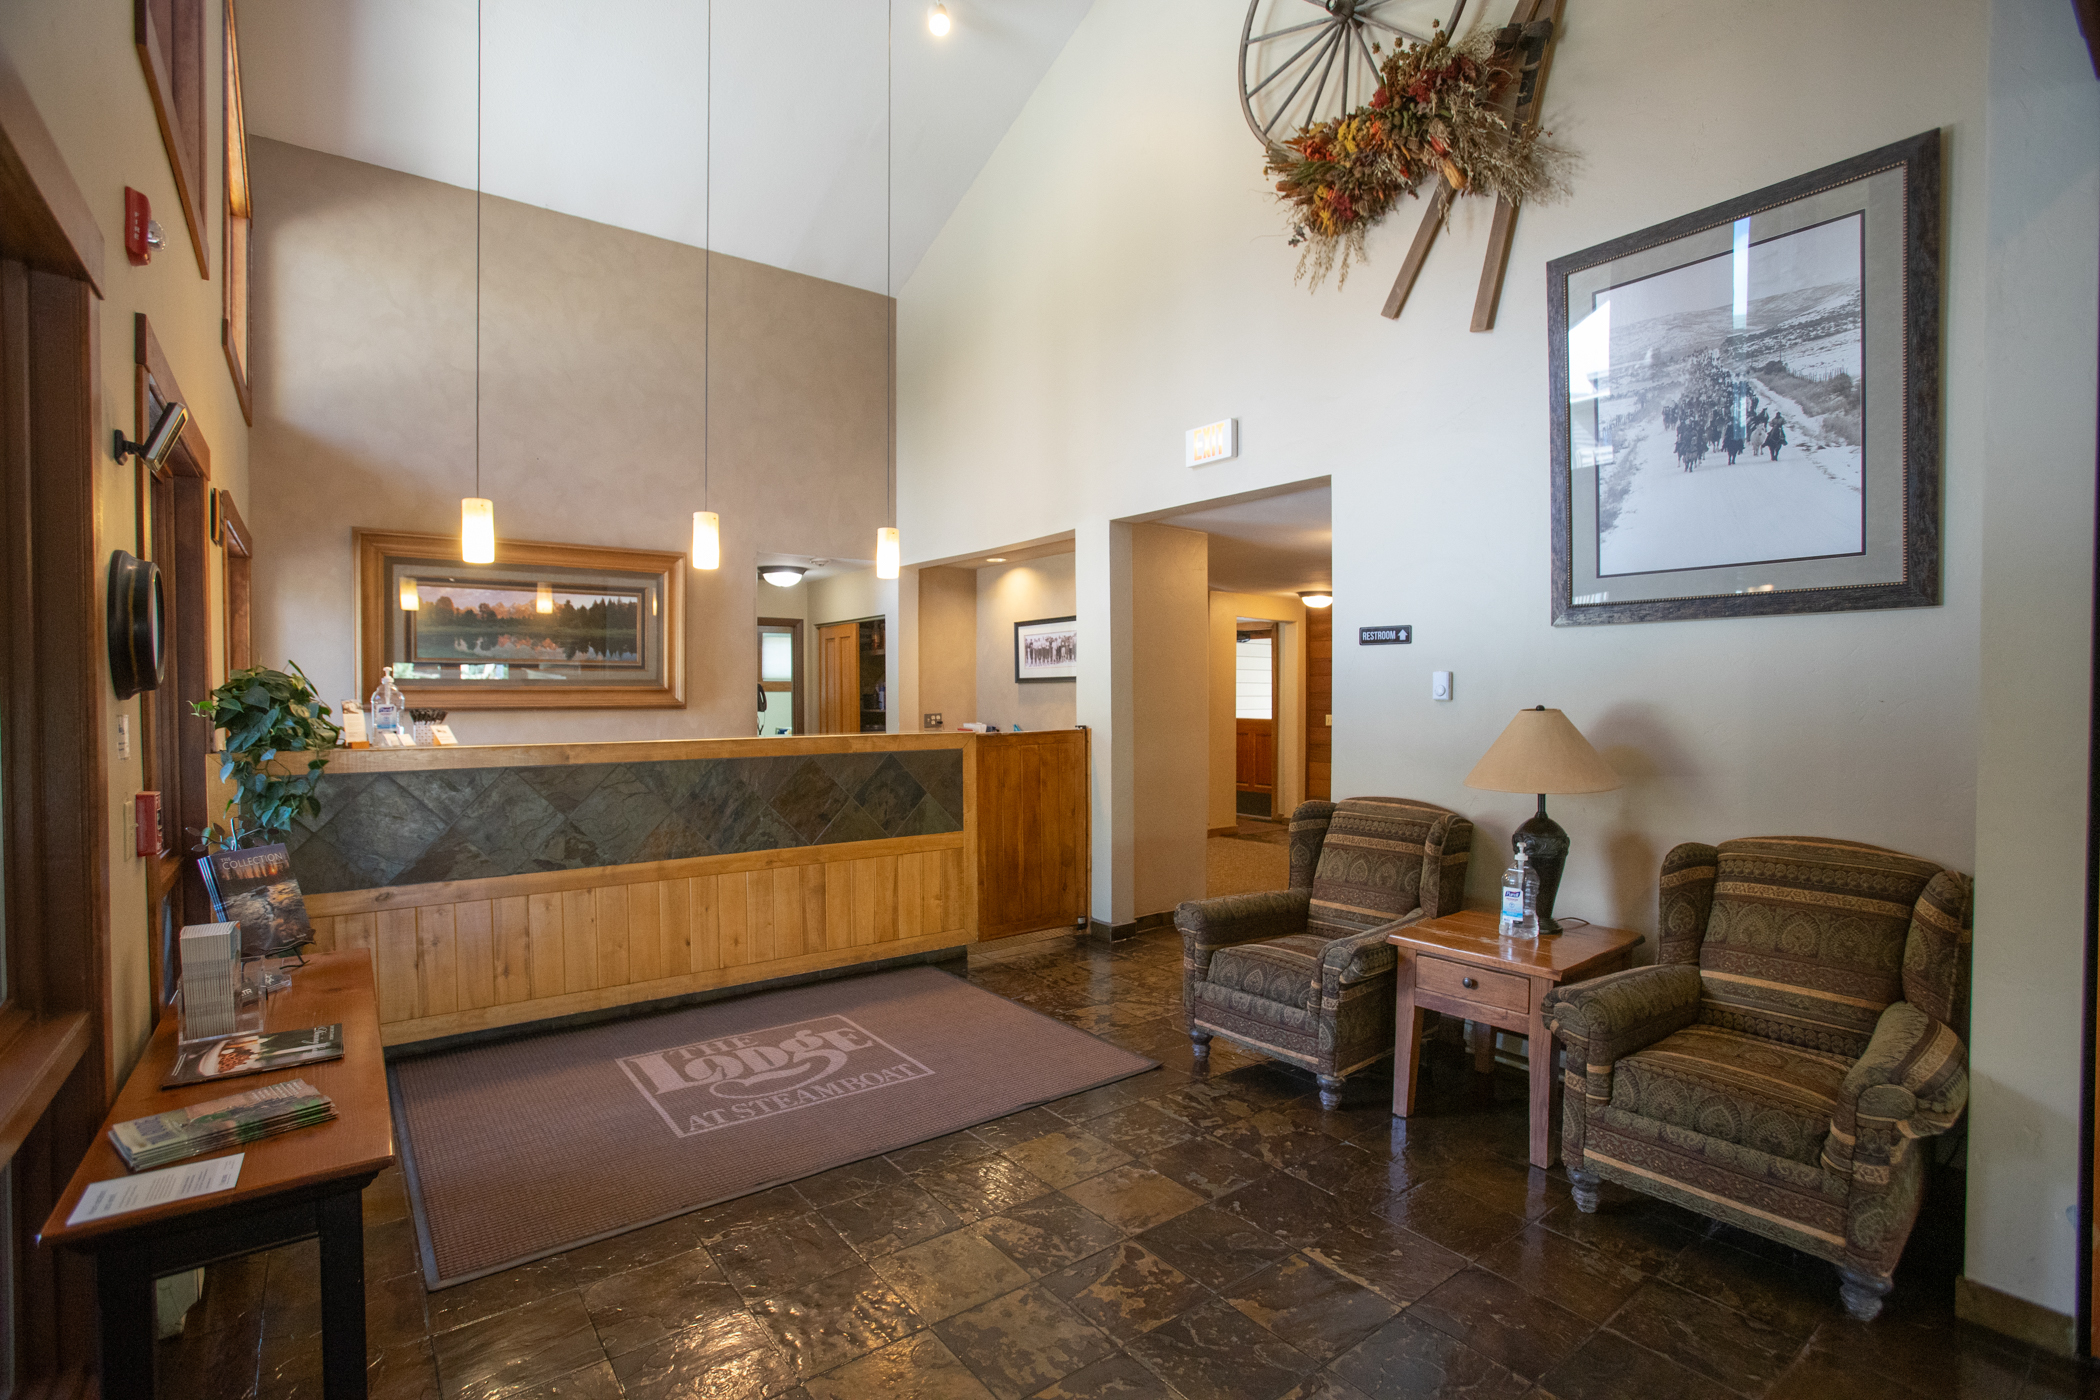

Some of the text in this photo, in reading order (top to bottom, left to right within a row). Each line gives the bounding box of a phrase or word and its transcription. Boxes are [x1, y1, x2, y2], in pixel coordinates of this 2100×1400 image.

[1193, 422, 1225, 461] EXIT
[1362, 630, 1396, 641] RESTROOM
[222, 852, 283, 870] COLLECTION
[668, 1034, 759, 1061] THE
[688, 1063, 913, 1132] AT STEAMBOAT
